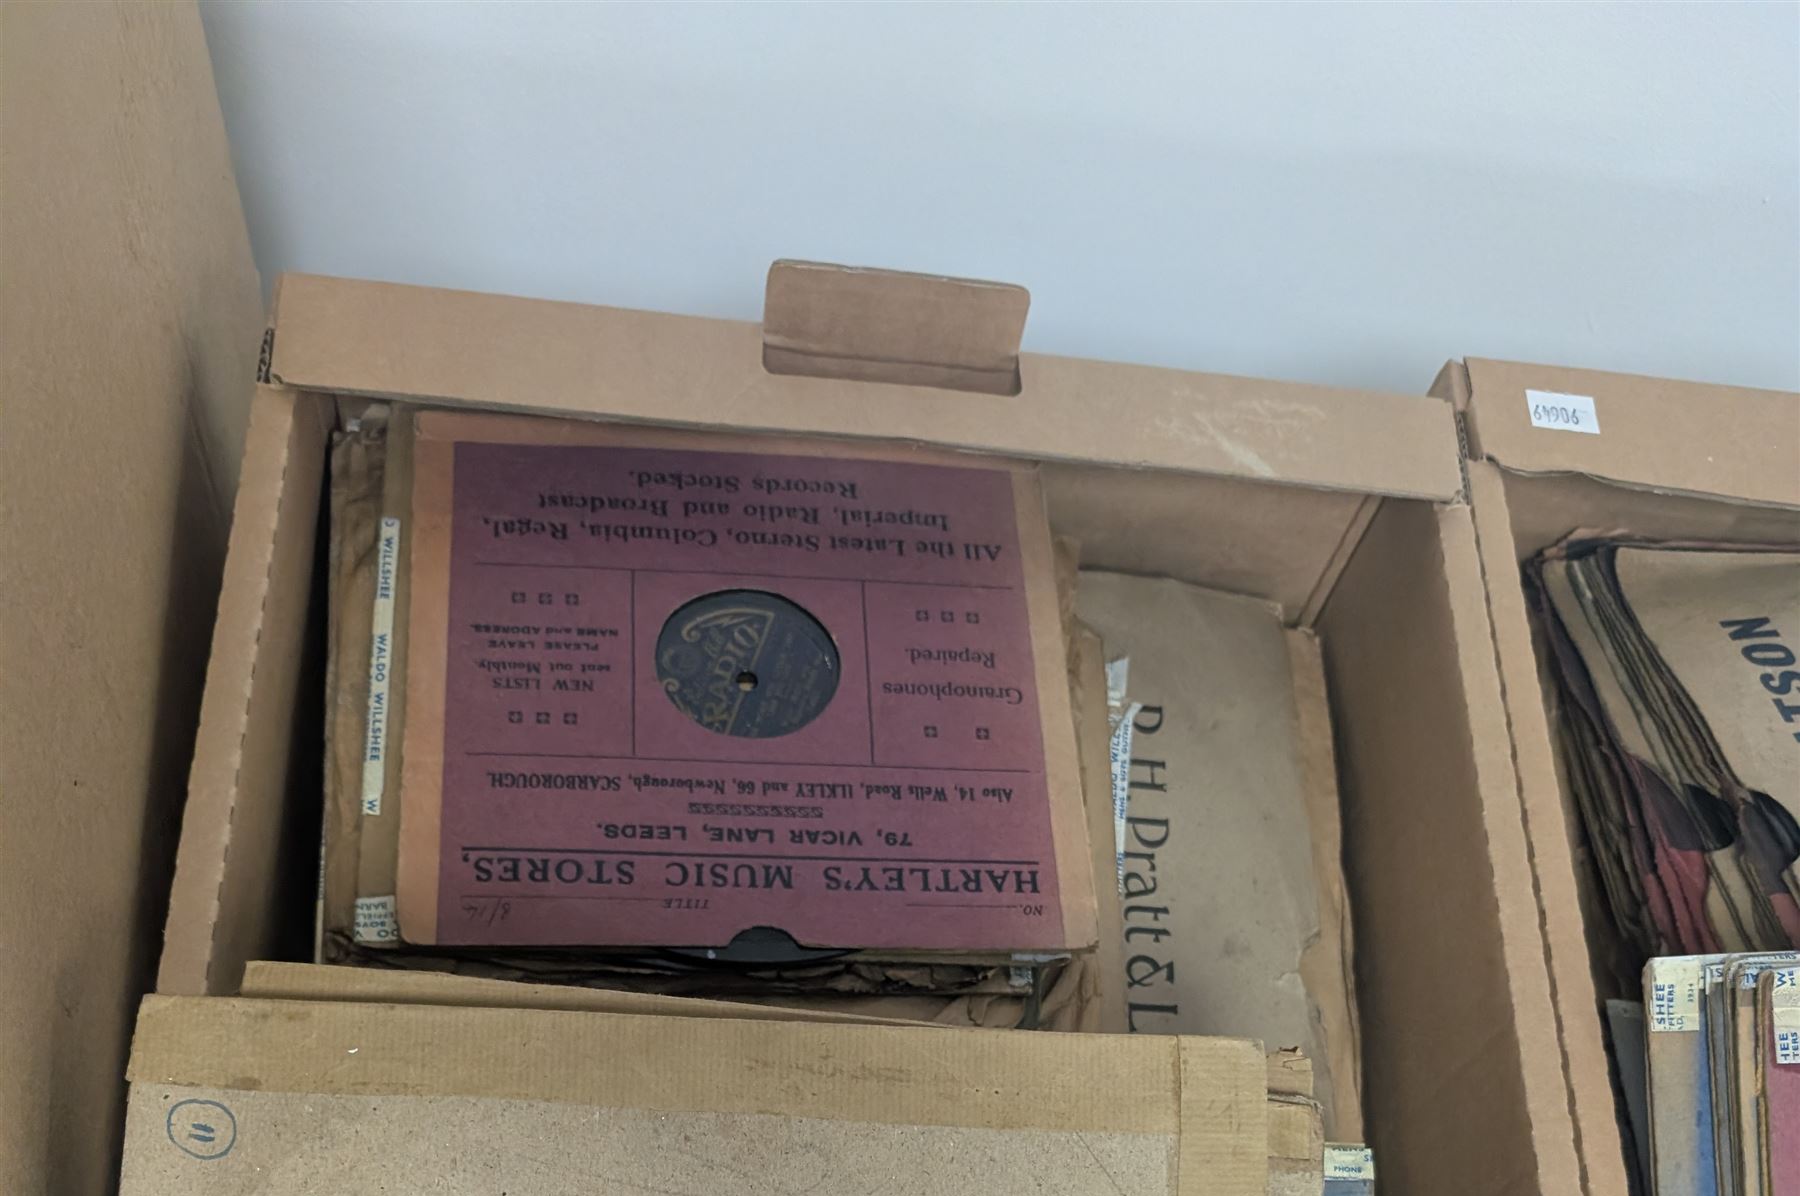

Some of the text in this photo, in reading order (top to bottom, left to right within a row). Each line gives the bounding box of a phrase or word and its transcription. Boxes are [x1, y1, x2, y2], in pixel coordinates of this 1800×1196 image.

[629, 471, 857, 499] Records Stocked.
[539, 494, 949, 532] Imperial, Radio and Broadcast
[483, 518, 1002, 562] All the Latest Sterno, Columbia, Regal,
[380, 537, 395, 599] WILLSHEE
[545, 626, 572, 635] and
[577, 627, 618, 637] NAME
[487, 640, 599, 651] PLEASE LEAVE
[904, 646, 995, 669] Repaired.
[474, 659, 611, 674] sent out Monthly.
[1719, 617, 1800, 743] TSON
[370, 634, 387, 760] WALDO WILLSHEE
[492, 678, 594, 692] NEW LISTS
[882, 681, 1023, 705] Gramophones
[487, 772, 1013, 801] Also 14, Wells Road, ILKLEY and 66, Newborough, SCARBOROUGH.
[597, 824, 912, 846] 79, VICAR LANE, LEEDS.
[462, 853, 1041, 894] HARTLEY'S MUSIC STORES,
[1123, 818, 1171, 943] Pratt
[663, 898, 1044, 916] NO. TITLE
[1126, 954, 1174, 990] &
